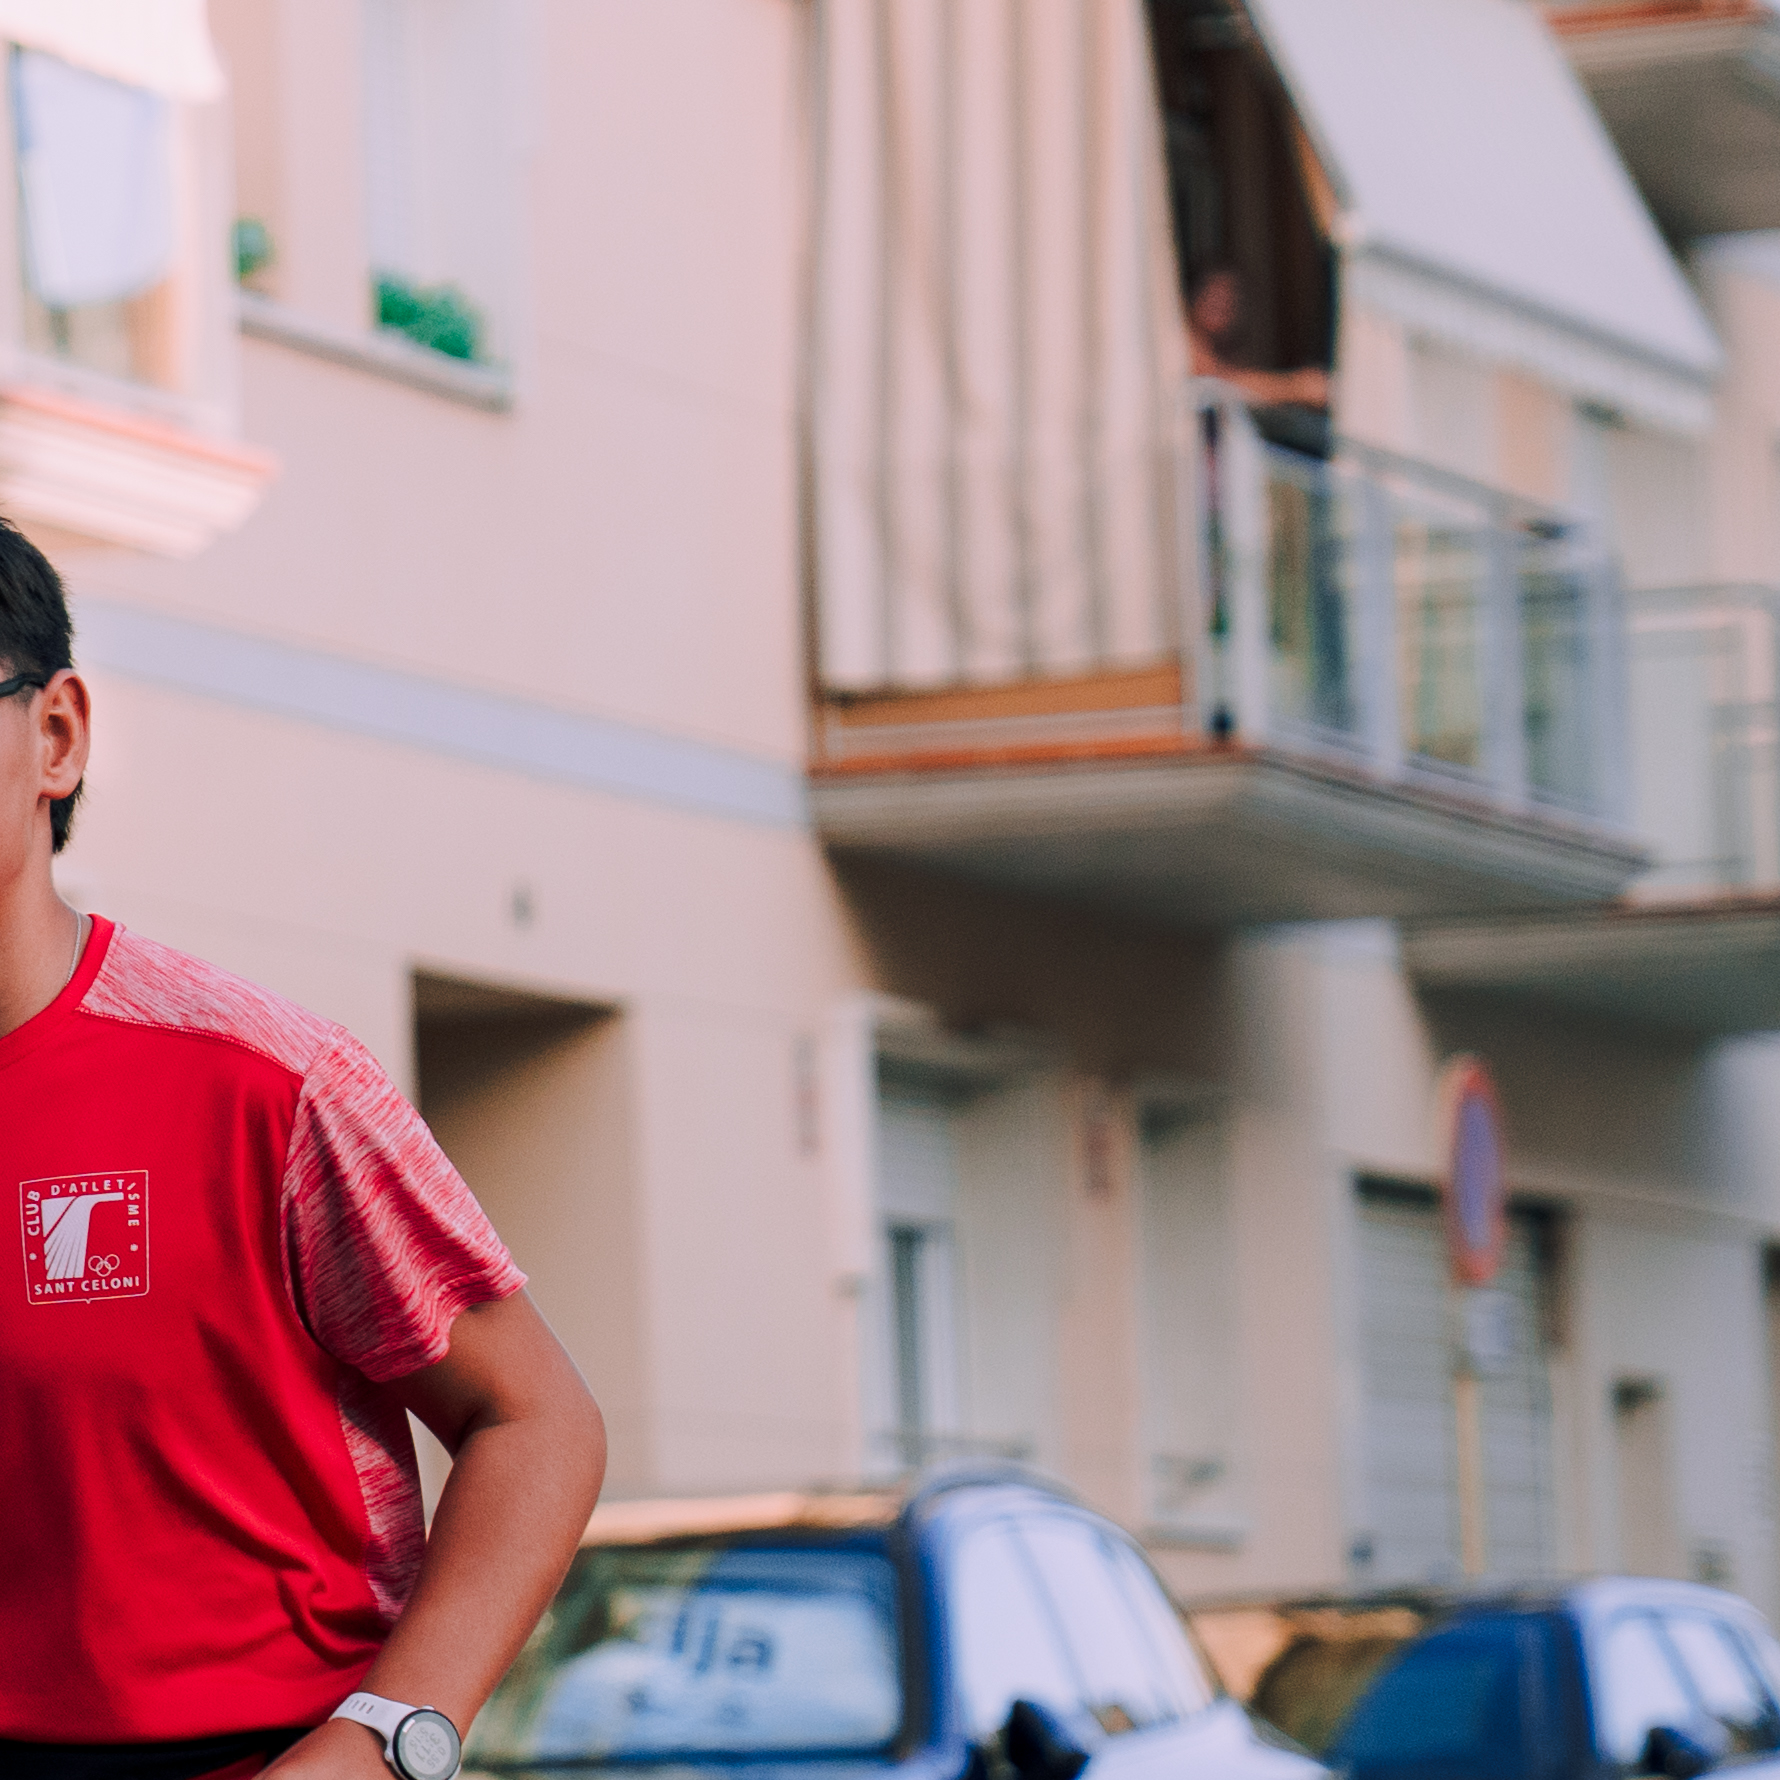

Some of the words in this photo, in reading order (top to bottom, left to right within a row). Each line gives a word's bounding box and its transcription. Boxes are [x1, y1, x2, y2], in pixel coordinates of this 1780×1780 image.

[25, 1190, 40, 1236] CLUB
[51, 1179, 140, 1227] D'ATLETISME
[34, 1281, 75, 1295] SANT
[81, 1276, 140, 1291] CELONI
